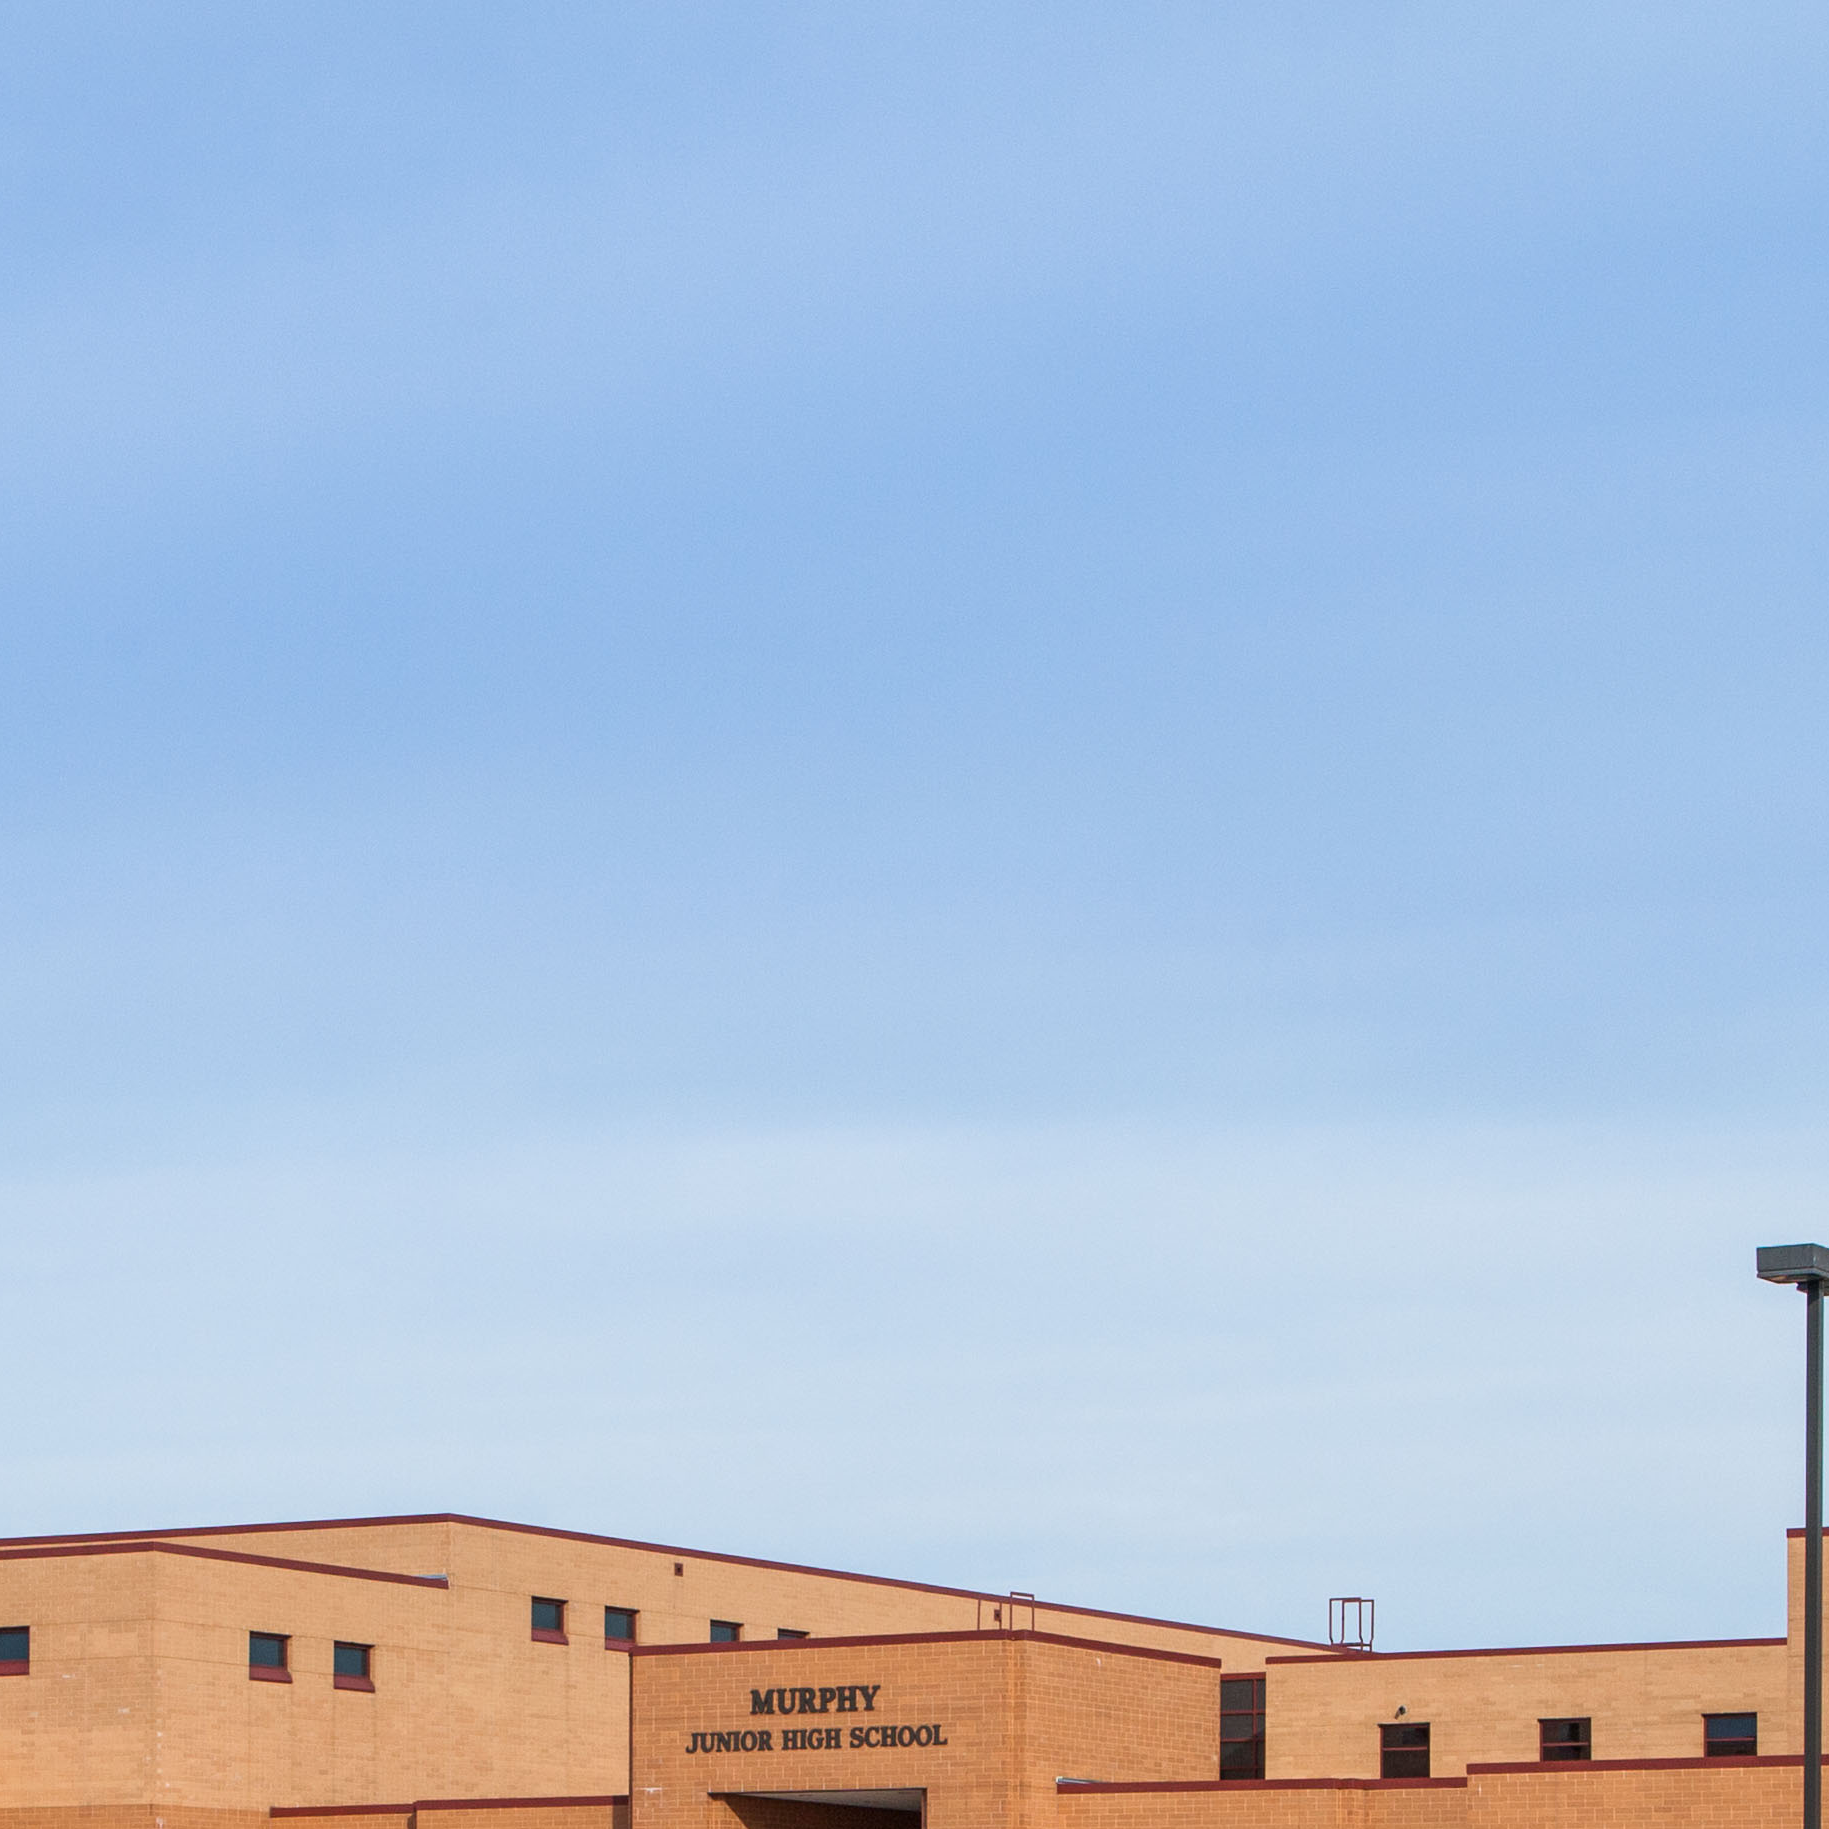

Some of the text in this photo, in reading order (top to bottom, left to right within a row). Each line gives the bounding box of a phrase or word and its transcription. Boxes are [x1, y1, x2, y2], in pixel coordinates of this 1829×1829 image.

[749, 1684, 881, 1715] MURPHY
[685, 1724, 948, 1754] JUNIOR HIGH SCHOOL
